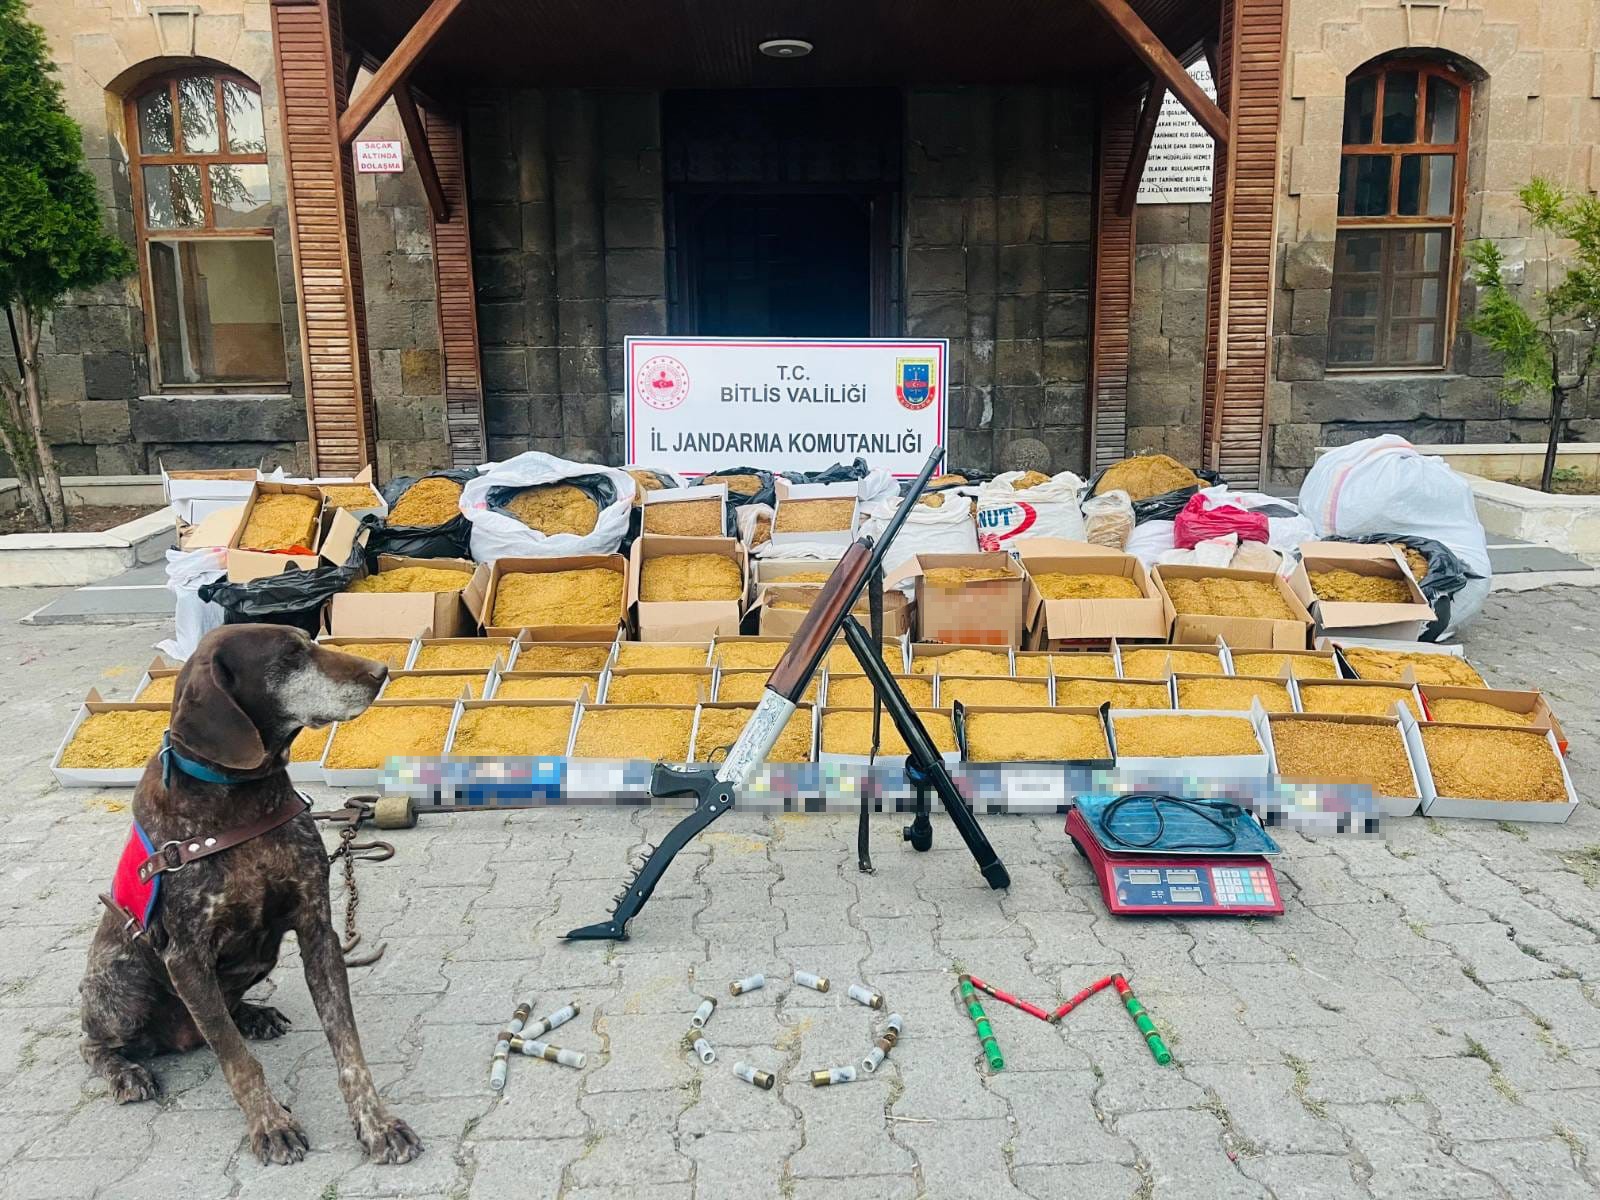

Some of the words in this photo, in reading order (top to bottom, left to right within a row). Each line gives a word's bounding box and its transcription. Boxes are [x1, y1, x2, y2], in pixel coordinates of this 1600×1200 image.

[361, 162, 401, 170] DOLAŞMA
[776, 365, 810, 381] T.C.
[720, 383, 781, 403] BİTLİS
[787, 383, 867, 403] VALİLİĞİ
[651, 427, 668, 453] İL
[672, 431, 783, 454] JANDARMA
[788, 429, 922, 454] KOMUTANLIĞI
